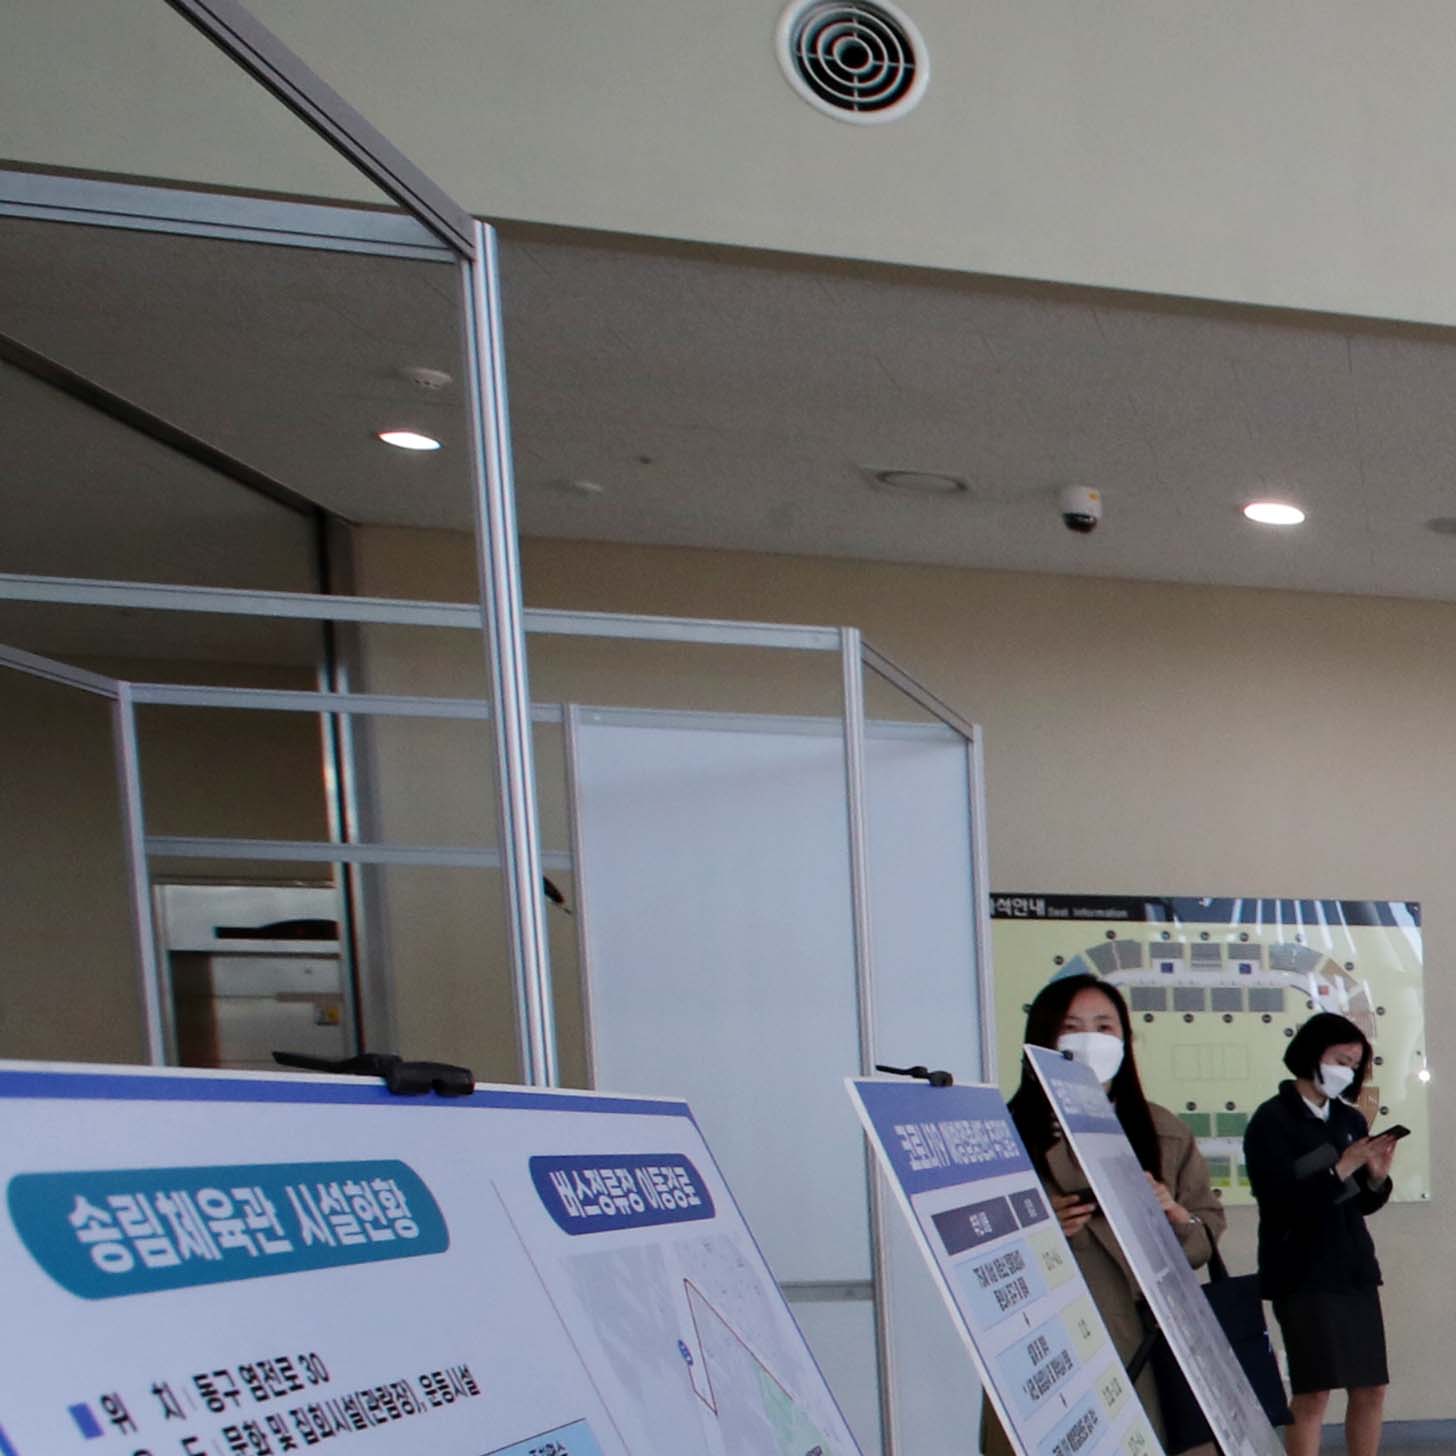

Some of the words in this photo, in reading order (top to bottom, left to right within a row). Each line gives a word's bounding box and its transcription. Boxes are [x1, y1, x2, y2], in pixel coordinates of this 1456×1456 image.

[990, 897, 1045, 916] 석안내
[71, 1187, 291, 1272] 송림체육관
[287, 1179, 418, 1245] 시설현황
[550, 1168, 645, 1217] 버스정류장
[635, 1166, 701, 1209] 이동경로
[99, 1393, 137, 1434] 위
[150, 1382, 186, 1420] 치
[192, 1369, 240, 1413] 동구
[238, 1356, 304, 1402] 염전로
[297, 1351, 330, 1386] 30
[265, 1415, 297, 1452] 및
[418, 1366, 480, 1407] 운동시설
